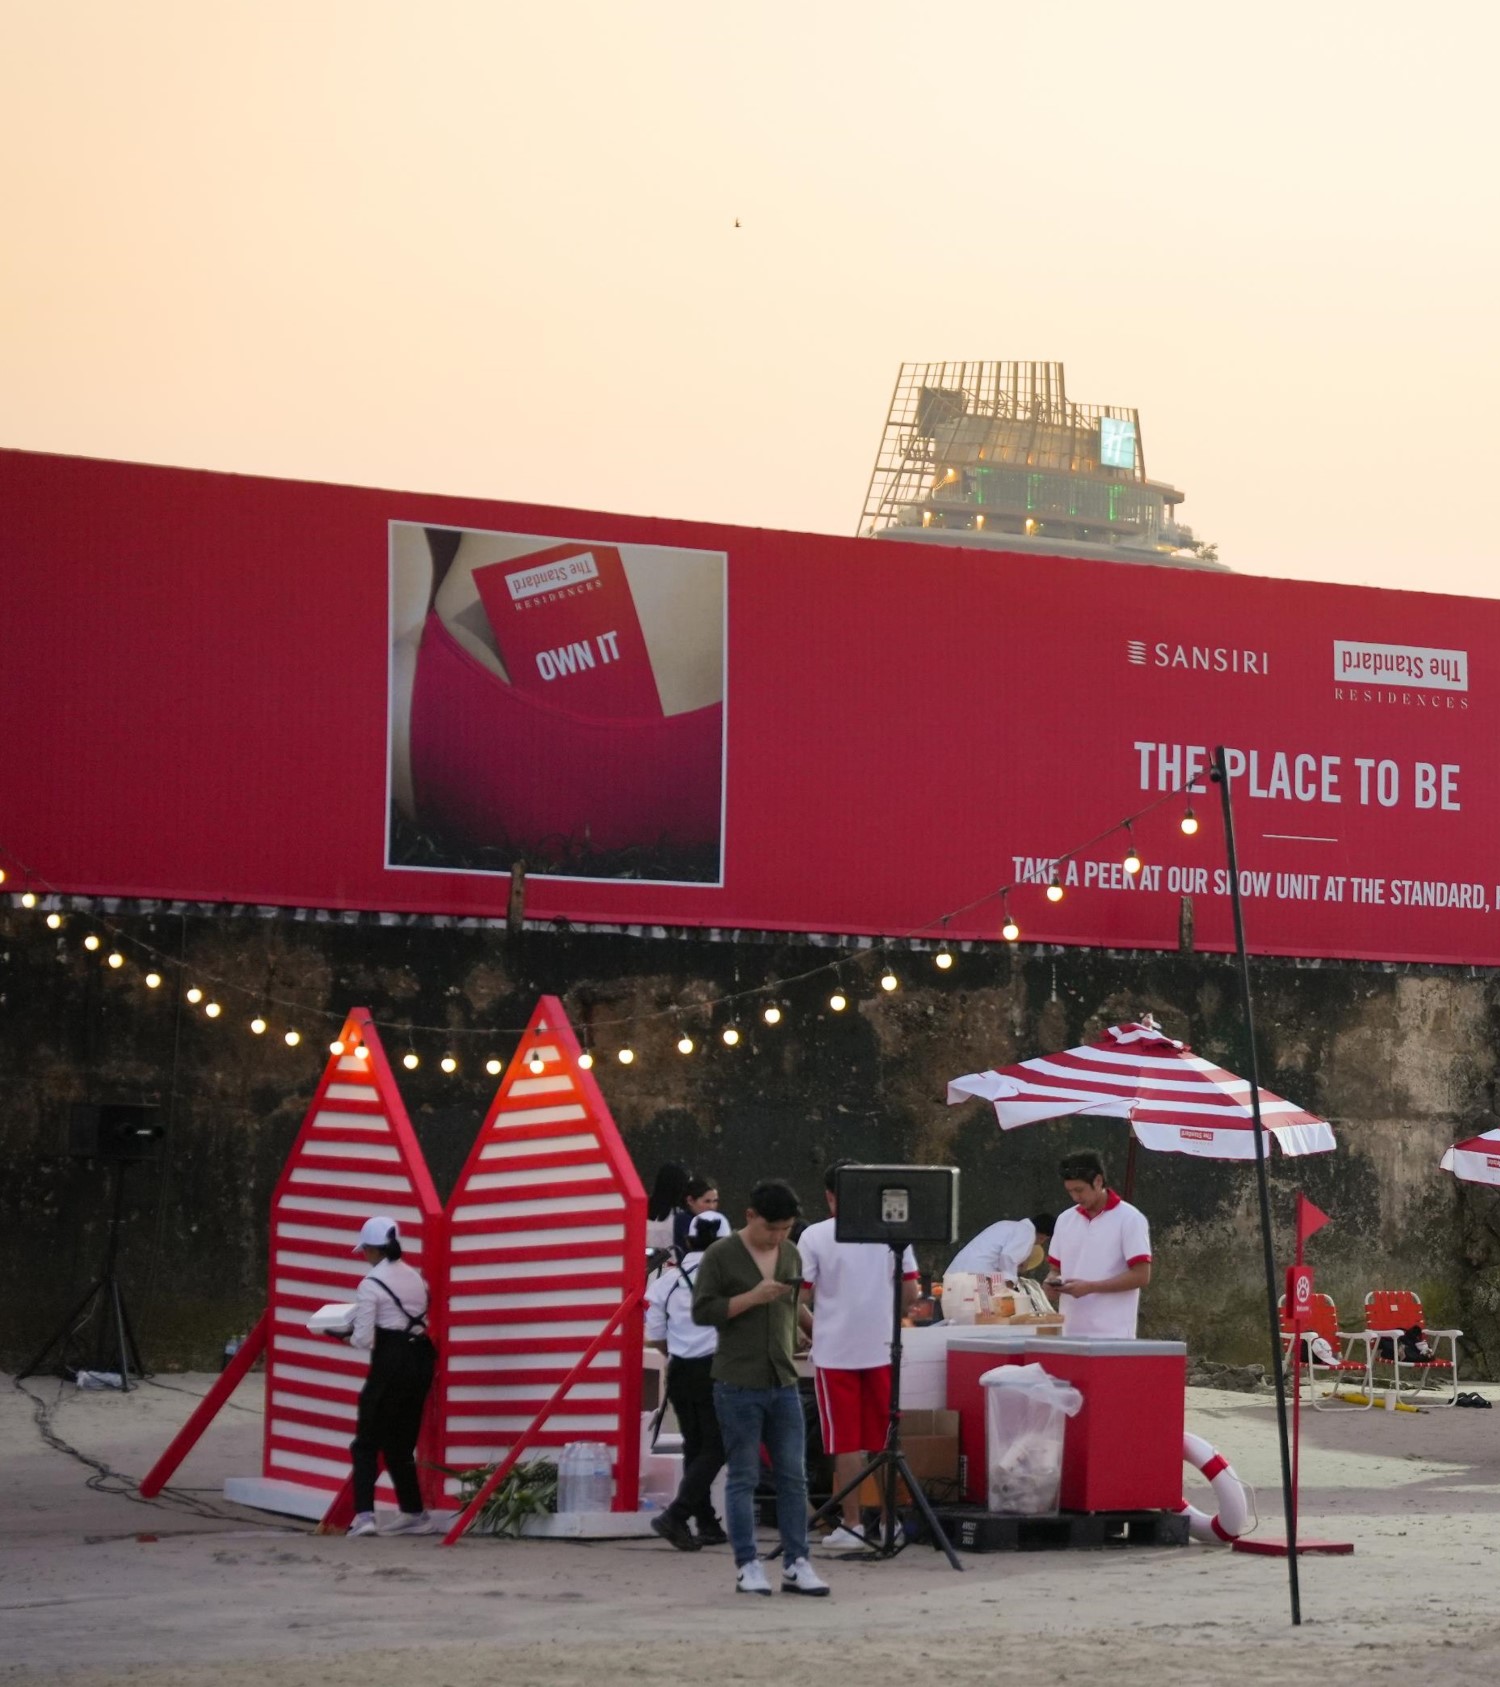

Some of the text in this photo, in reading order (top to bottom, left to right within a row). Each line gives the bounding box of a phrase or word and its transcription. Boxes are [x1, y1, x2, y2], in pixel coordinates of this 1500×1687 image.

[513, 559, 592, 594] The Standard
[514, 579, 603, 611] RESIDENCES
[535, 630, 620, 681] OWN IT
[1154, 643, 1269, 675] SANSIRI
[1342, 650, 1462, 682] The Standard
[1334, 688, 1469, 710] RESIDENCES
[1134, 741, 1461, 811] THE PLACE TO BE
[1065, 860, 1079, 886] A
[1139, 865, 1163, 891] AT
[1167, 866, 1208, 894] OUR
[1276, 873, 1320, 900] UNIT
[1324, 876, 1346, 901] AT
[1350, 877, 1385, 904] THE
[1390, 879, 1490, 913] STANDARD,
